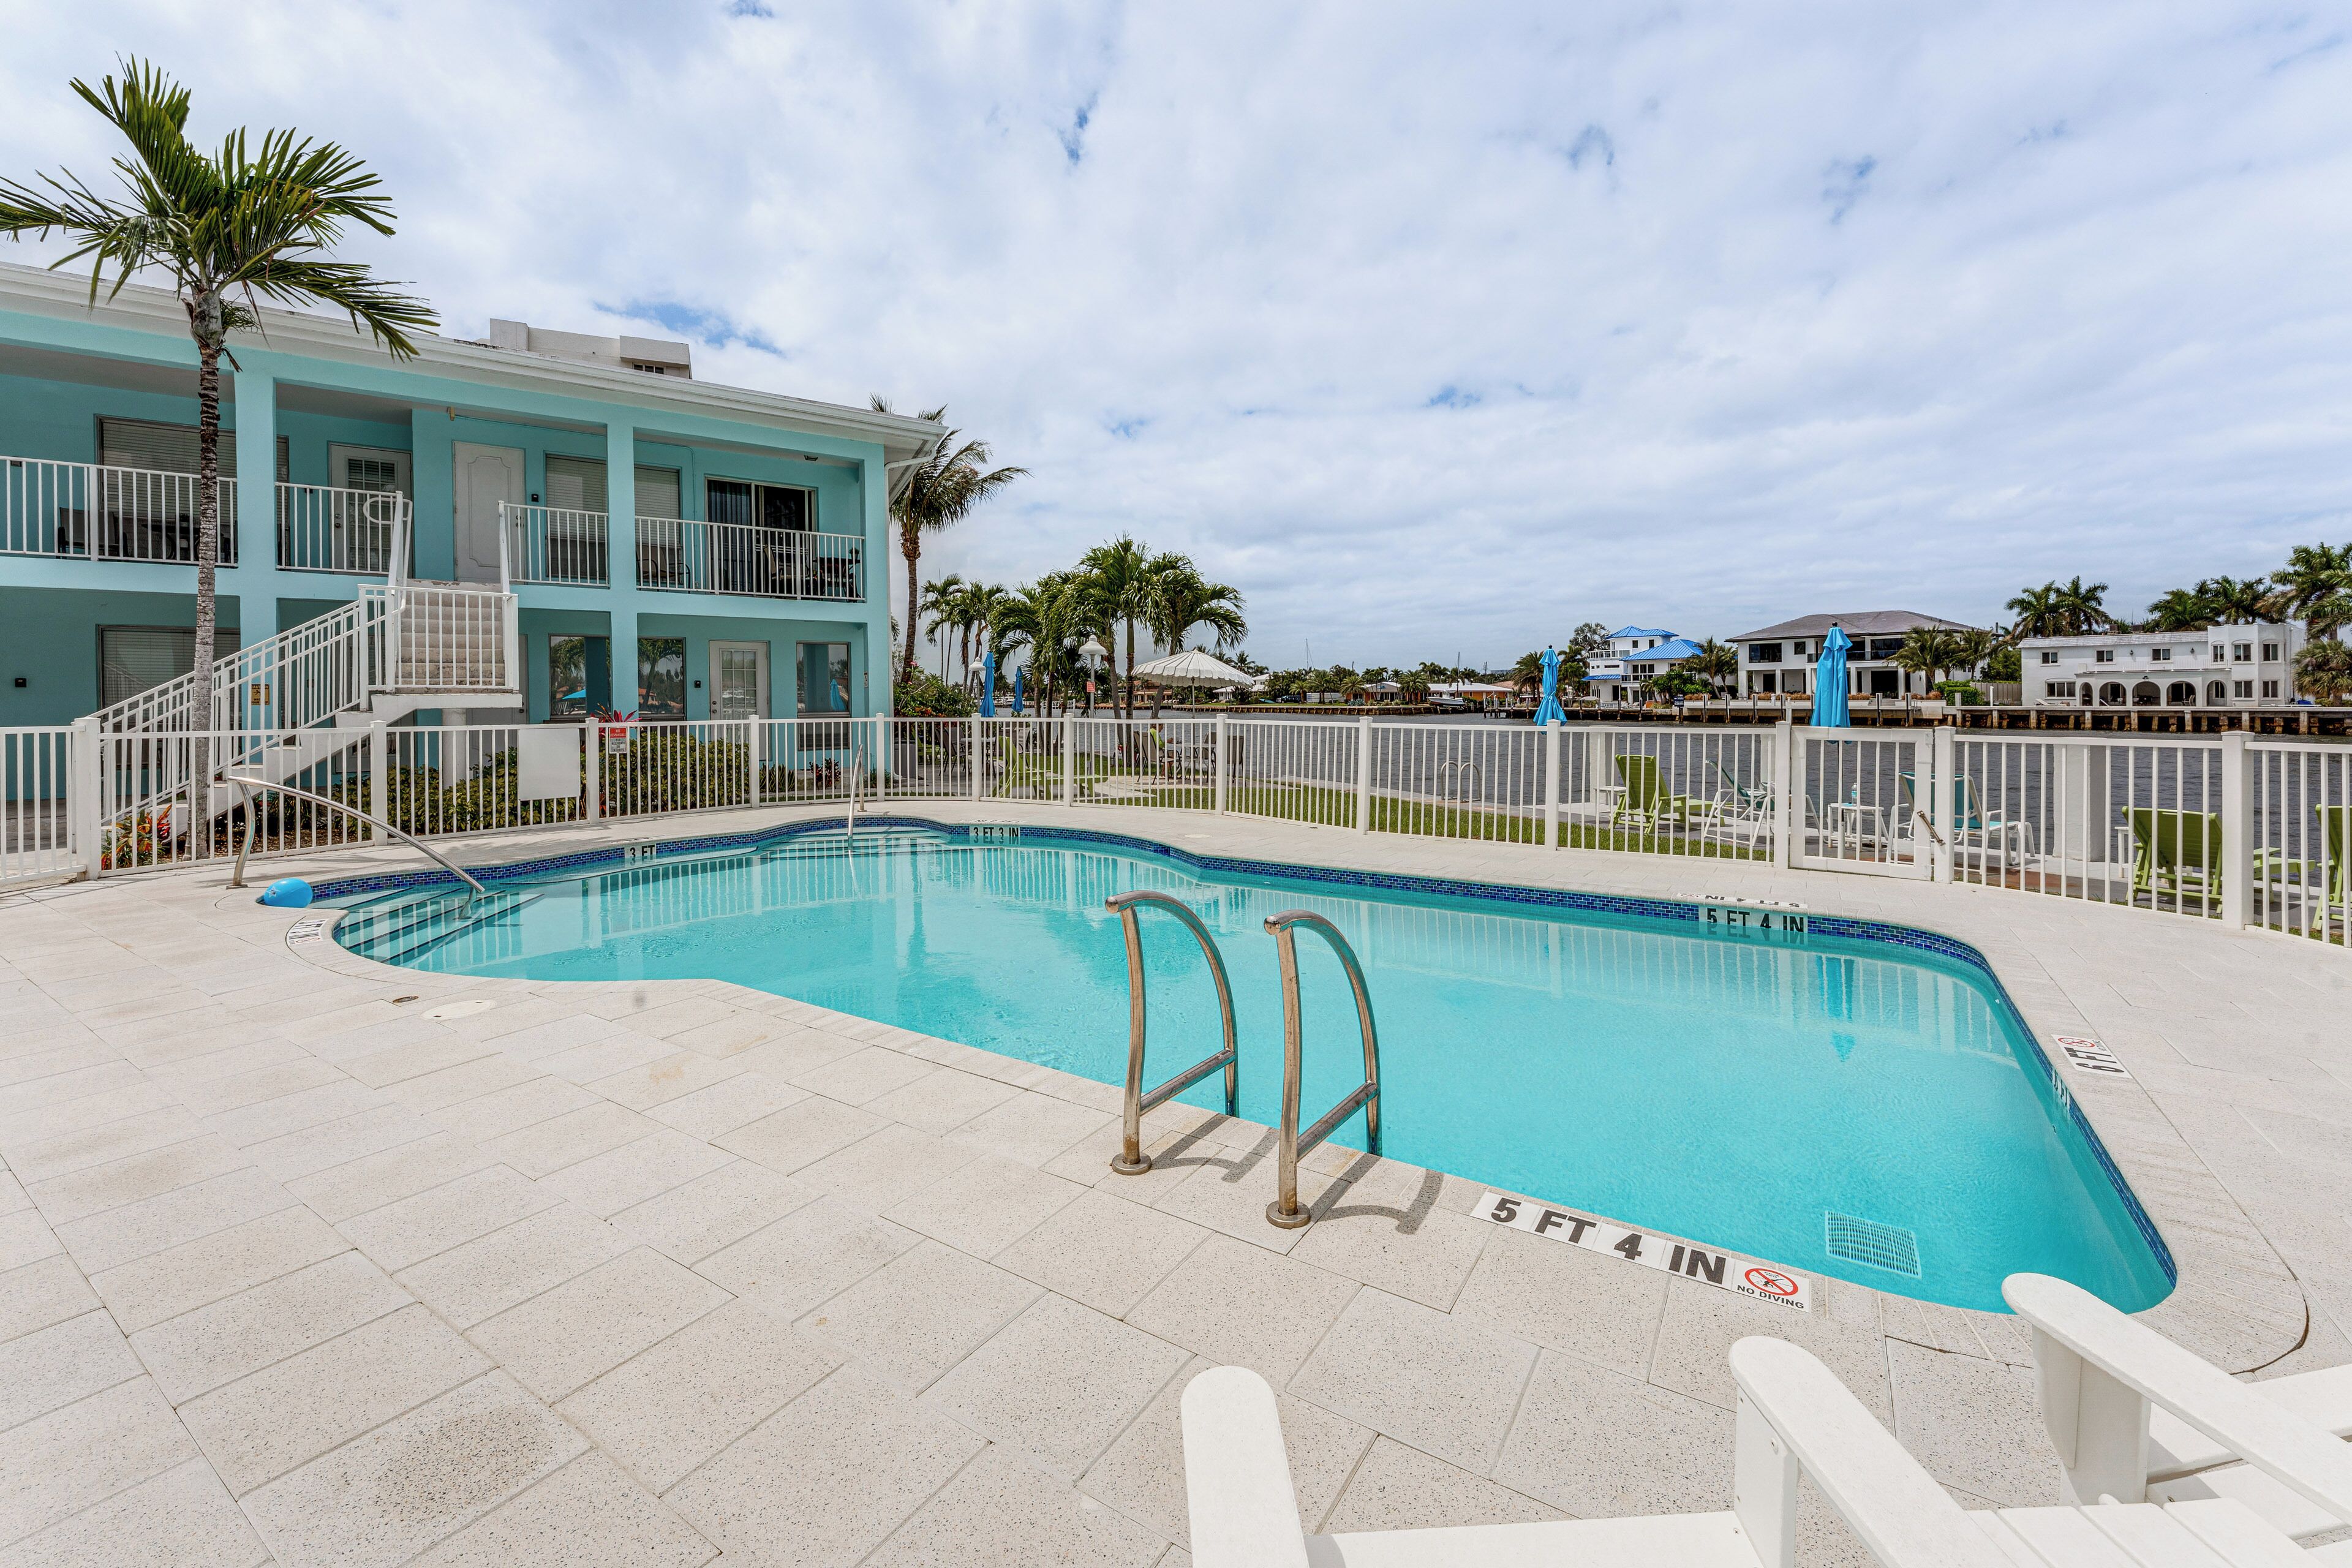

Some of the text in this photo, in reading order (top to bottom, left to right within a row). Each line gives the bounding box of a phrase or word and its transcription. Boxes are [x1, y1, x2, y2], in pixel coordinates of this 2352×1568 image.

[973, 827, 1019, 837] 3 FT 3 IN
[630, 845, 655, 858] 3 FT
[1706, 908, 1804, 932] 5 FT 4 IN
[2064, 1047, 2125, 1072] 6 FT
[1491, 1197, 1727, 1285] 5 FT 4 IN
[1737, 1284, 1804, 1309] NO DIVING
